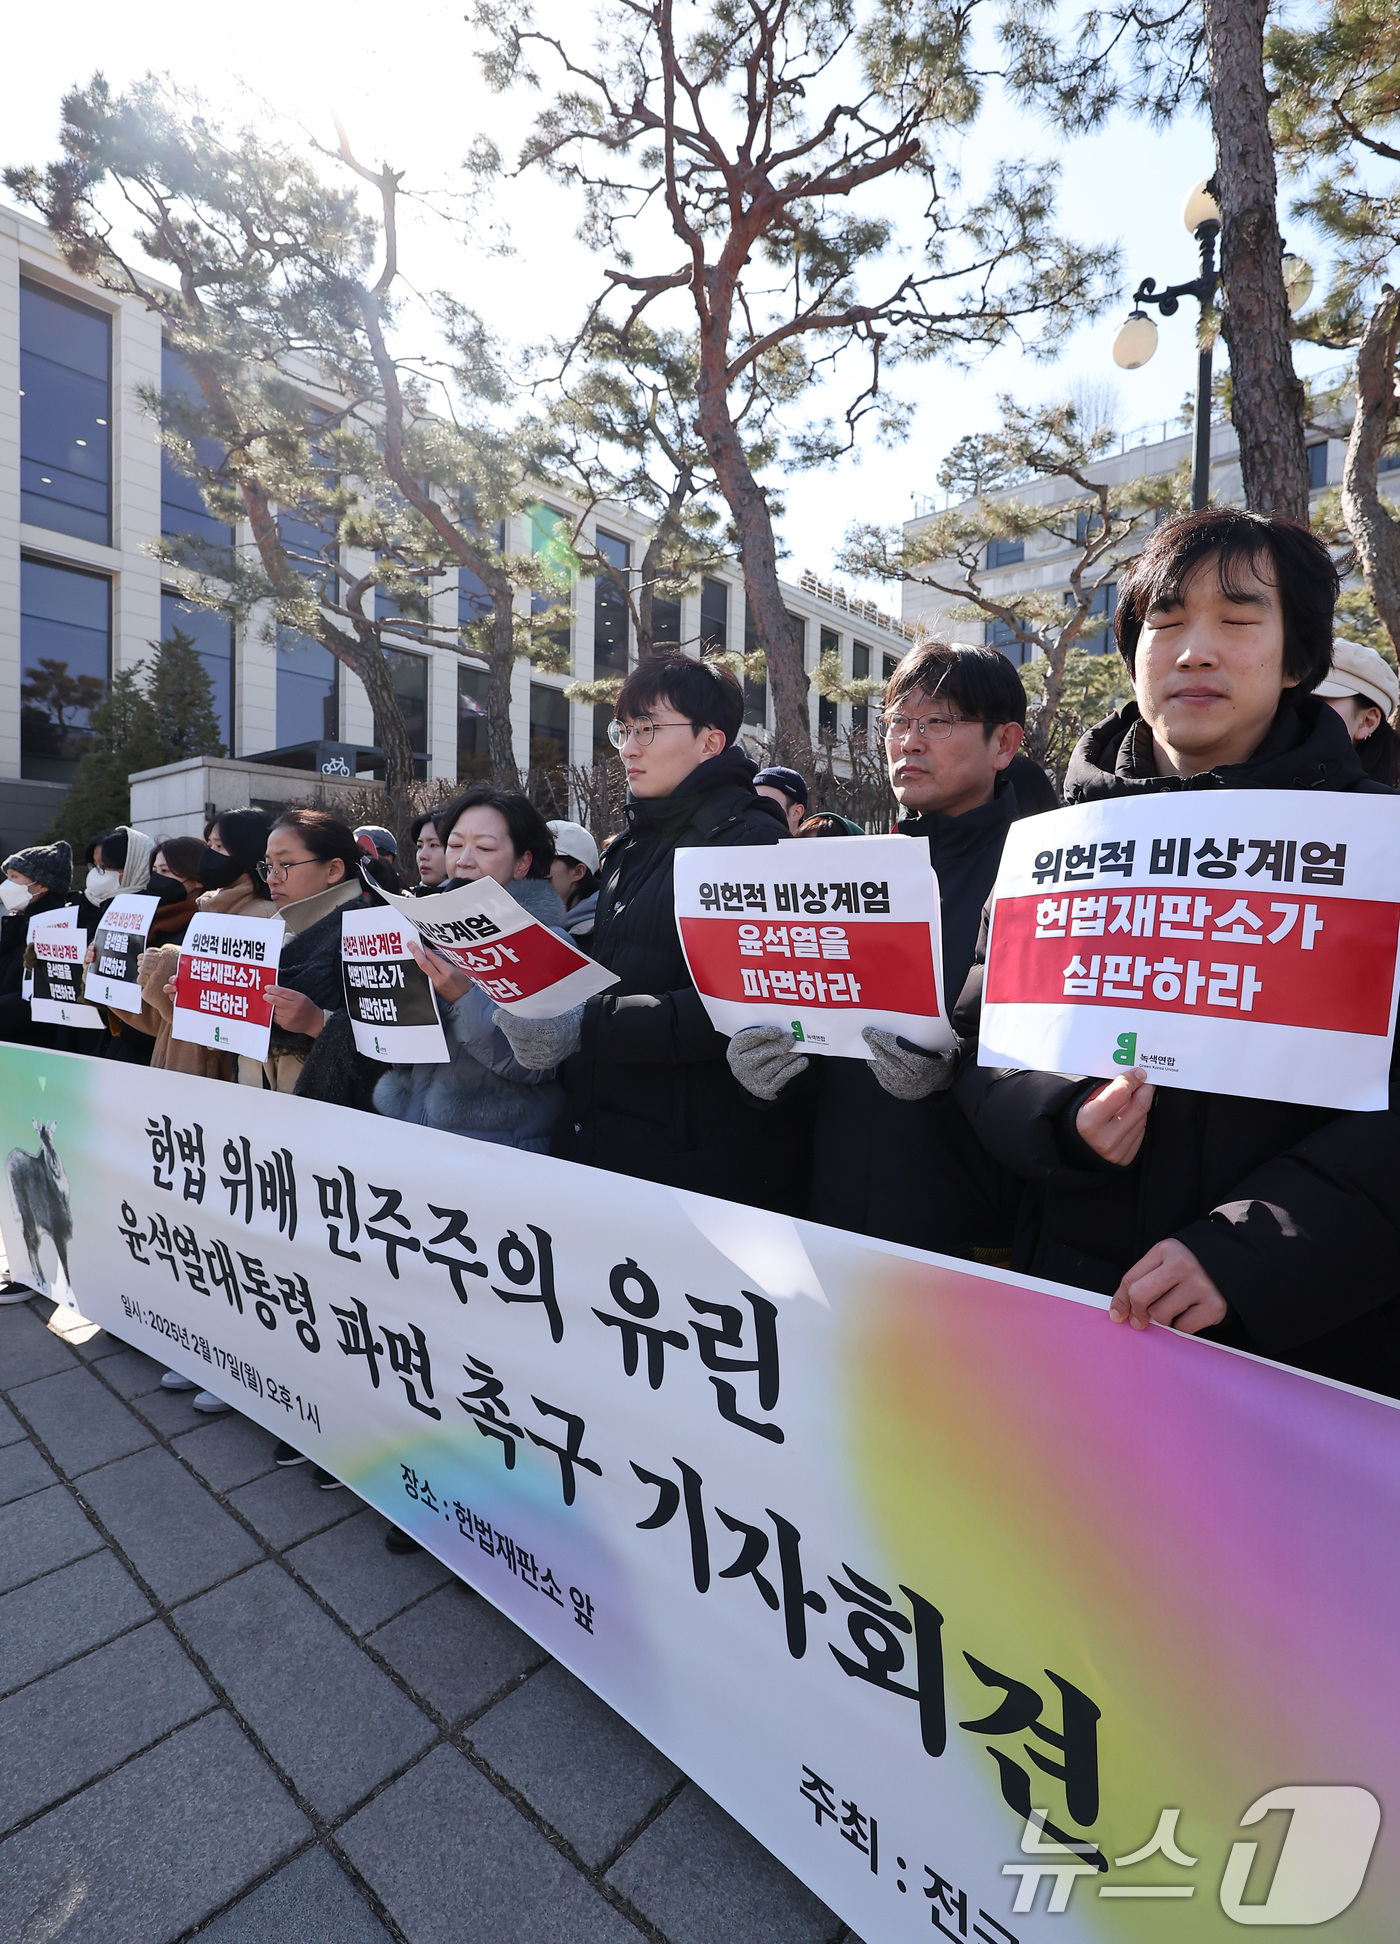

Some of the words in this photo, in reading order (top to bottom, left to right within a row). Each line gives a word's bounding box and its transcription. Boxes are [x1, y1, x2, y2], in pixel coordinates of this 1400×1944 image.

[1032, 840, 1136, 885] 위헌적
[1148, 837, 1347, 886] 비상계엄
[699, 882, 768, 912] 위헌적
[774, 881, 891, 915] 비상계엄
[1034, 894, 1324, 950] 헌법재판소가
[52, 944, 78, 960] 비상계엄
[104, 932, 129, 954] 윤석열을
[191, 933, 218, 954] 위헌적
[221, 935, 266, 961] 비상계엄
[358, 932, 403, 957] 비상계엄
[738, 924, 851, 960] 윤석열을
[46, 962, 73, 981] 윤석열을
[99, 956, 127, 978] 파면하라
[190, 958, 261, 991] 헌법재판소가
[347, 964, 405, 989] 헌법재판소가
[1062, 954, 1263, 1012] 심판하라
[49, 982, 76, 1001] 파면하라
[740, 968, 862, 1003] 파면하라
[199, 988, 249, 1018] 심판하라
[358, 996, 398, 1022] 심판하라
[1140, 1053, 1176, 1067] 녹색연합
[145, 1114, 207, 1206] 헌법
[219, 1135, 299, 1242] 위배
[312, 1165, 564, 1344] 민주주의
[591, 1257, 785, 1445] 유린
[148, 1310, 191, 1351] 2025년
[191, 1334, 213, 1364] 2월
[213, 1347, 263, 1398] 17일(월)
[267, 1377, 294, 1413] 오후
[296, 1395, 322, 1434] 1시
[117, 1198, 322, 1354] 윤석열대통령
[329, 1296, 442, 1421] 파면
[456, 1353, 602, 1506] 촉구
[630, 1457, 1109, 1873] 기자회견
[400, 1463, 440, 1513] 장소
[453, 1500, 565, 1608] 헌법재판소
[569, 1586, 595, 1636] 앞
[800, 1764, 878, 1875] 주최
